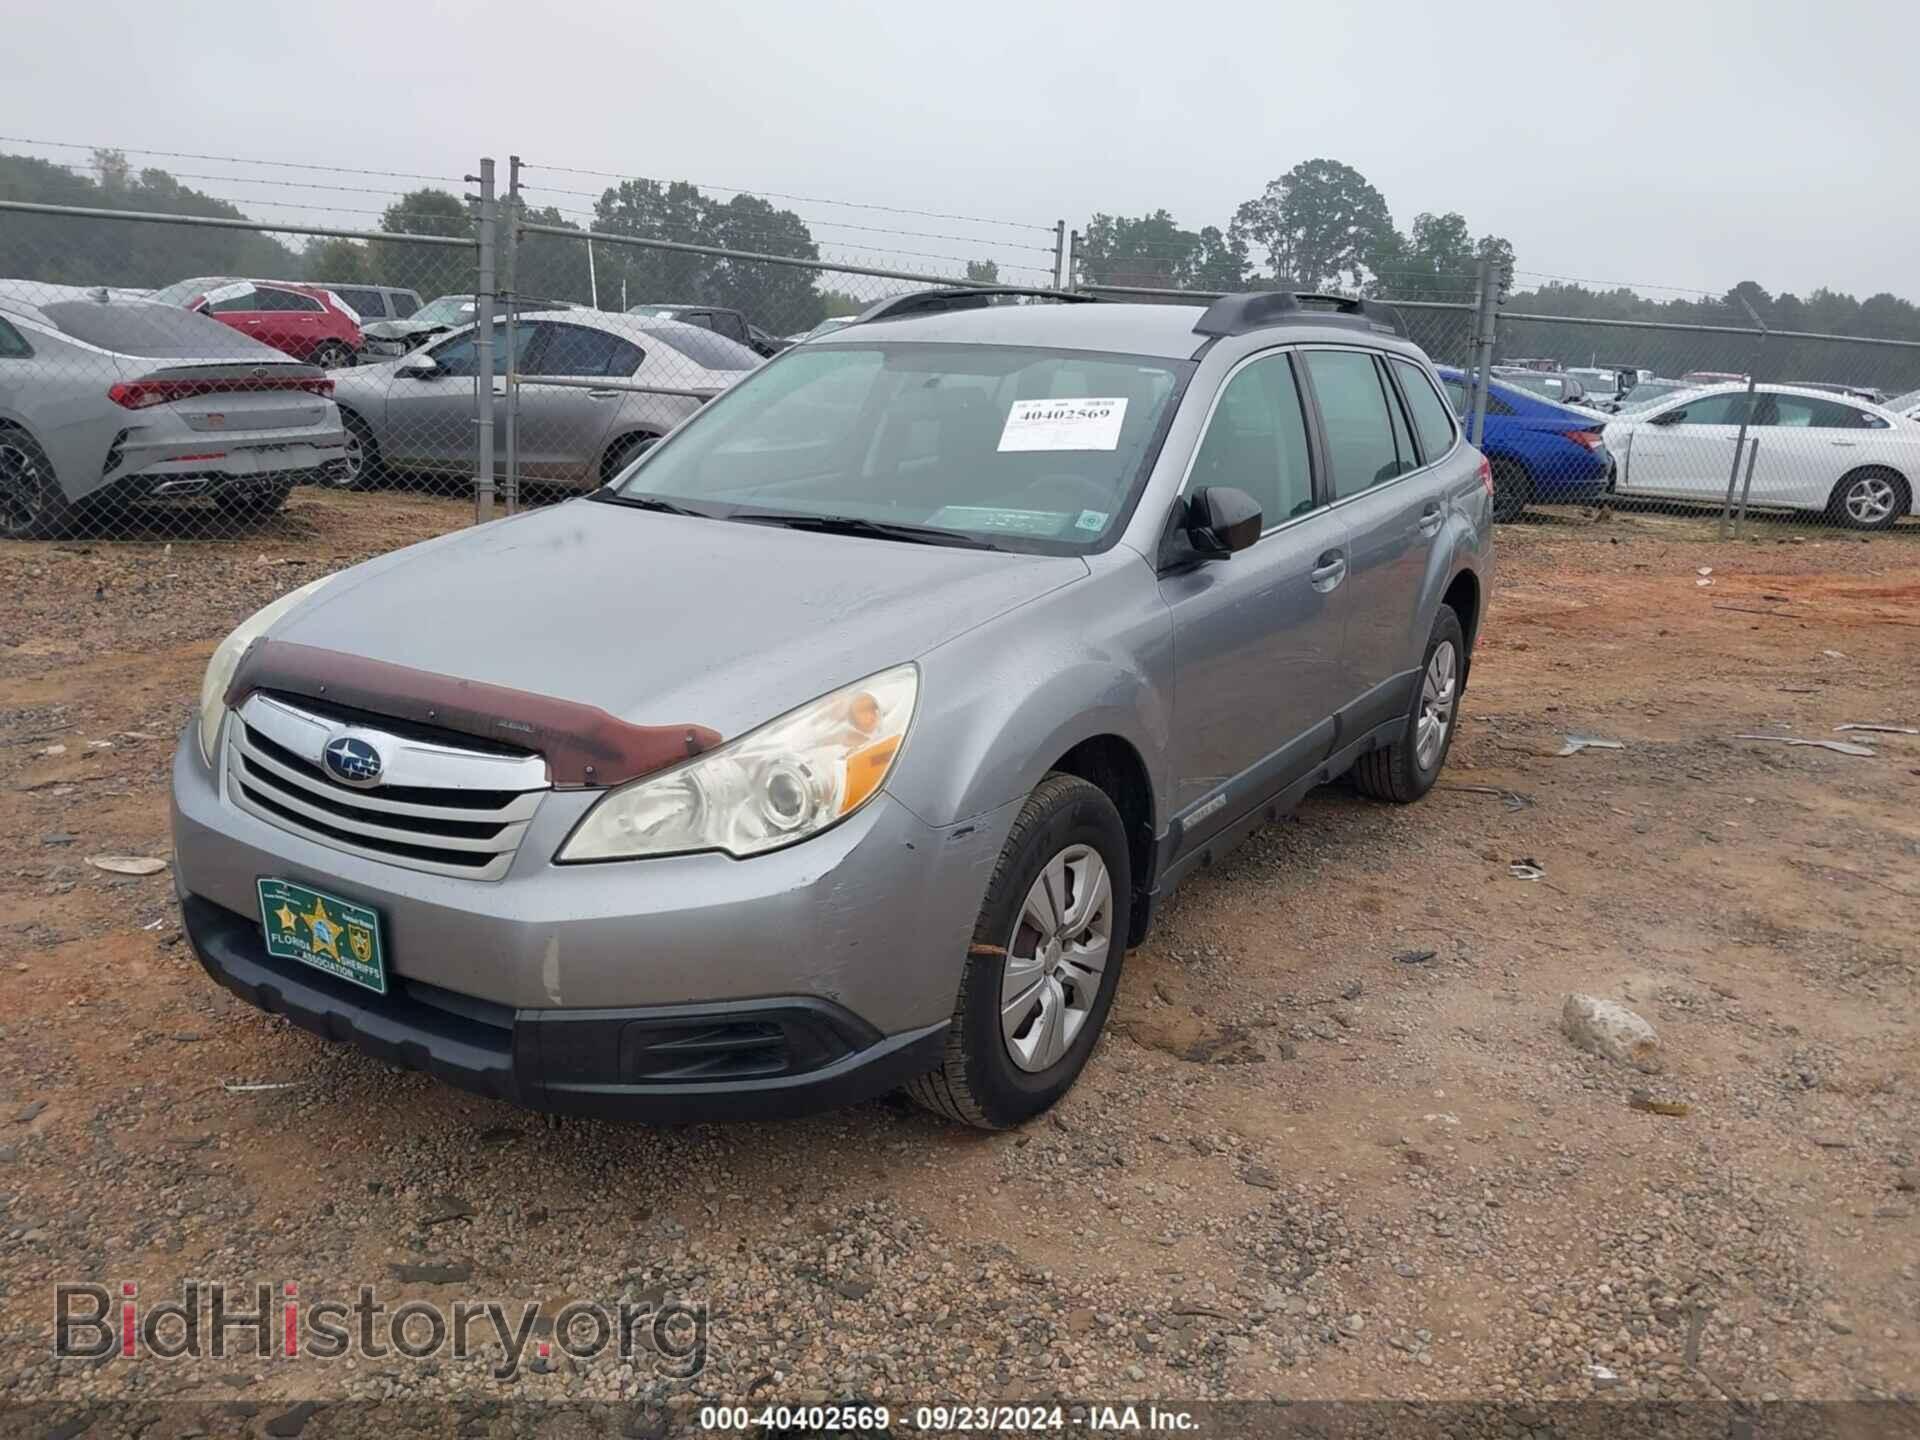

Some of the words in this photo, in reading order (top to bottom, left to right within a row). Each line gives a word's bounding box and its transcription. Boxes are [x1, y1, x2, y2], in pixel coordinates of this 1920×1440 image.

[1020, 408, 1110, 421] 40402569
[271, 933, 311, 951] FLORIDA
[302, 952, 354, 979] ASSOCIATION
